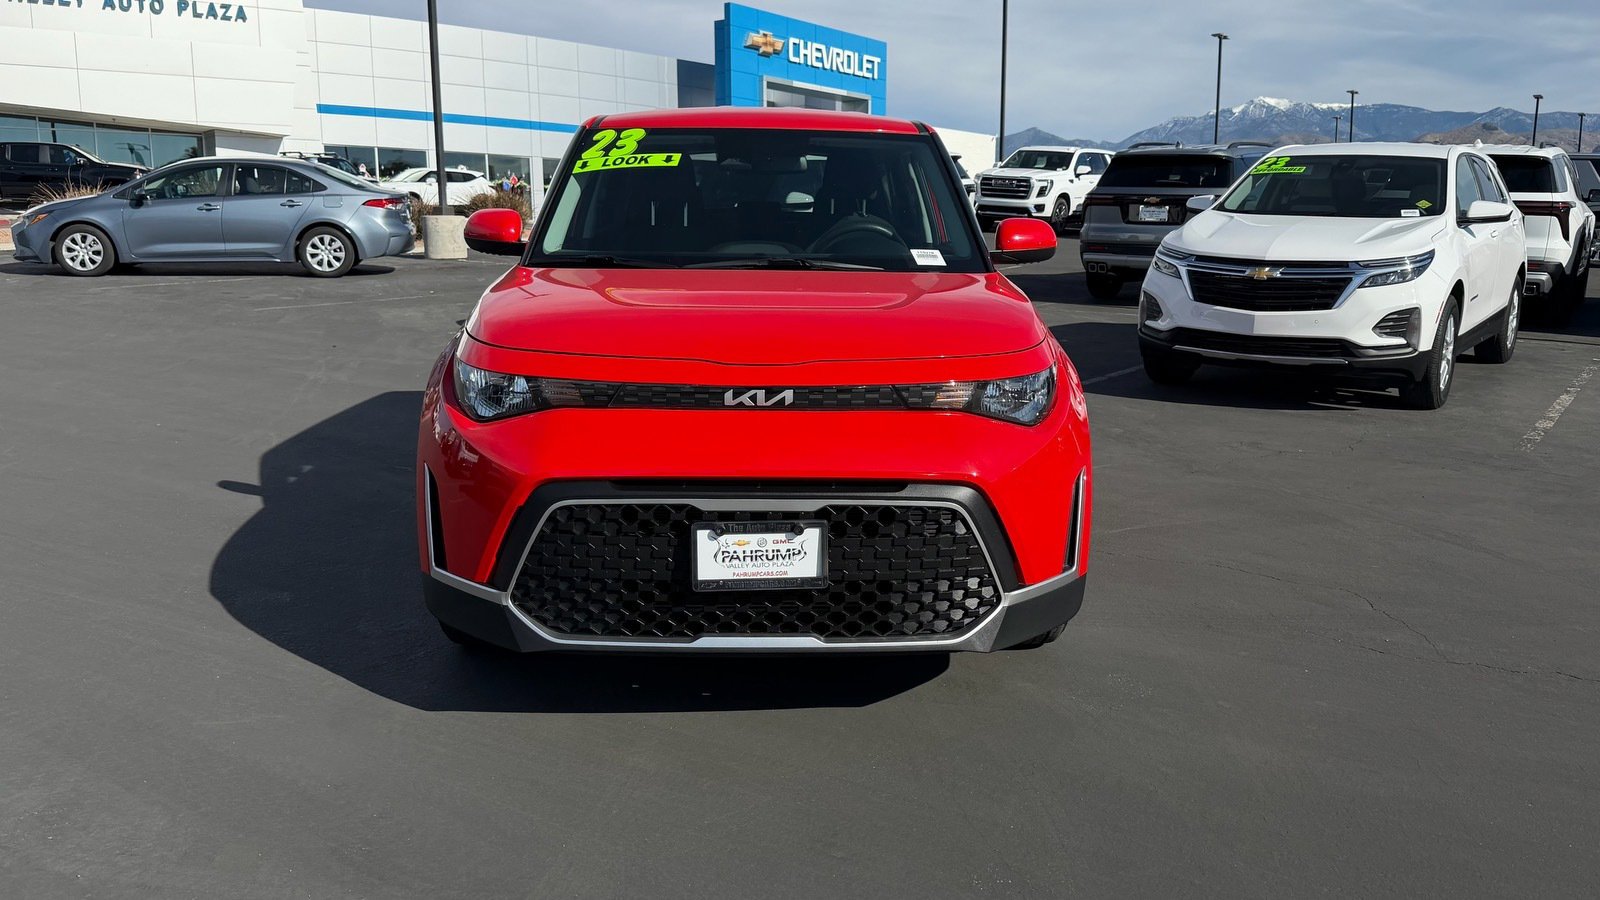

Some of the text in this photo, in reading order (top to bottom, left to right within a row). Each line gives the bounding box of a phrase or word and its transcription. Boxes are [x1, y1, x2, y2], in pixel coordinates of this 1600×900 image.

[102, 0, 164, 15] AUTO
[177, 0, 248, 23] PLAZA
[788, 36, 882, 80] CHEVROLET
[581, 128, 647, 160] 23
[601, 155, 653, 168] LOOK
[1257, 156, 1291, 169] 23
[724, 388, 794, 407] KIA
[721, 548, 802, 563] PAHRUMP
